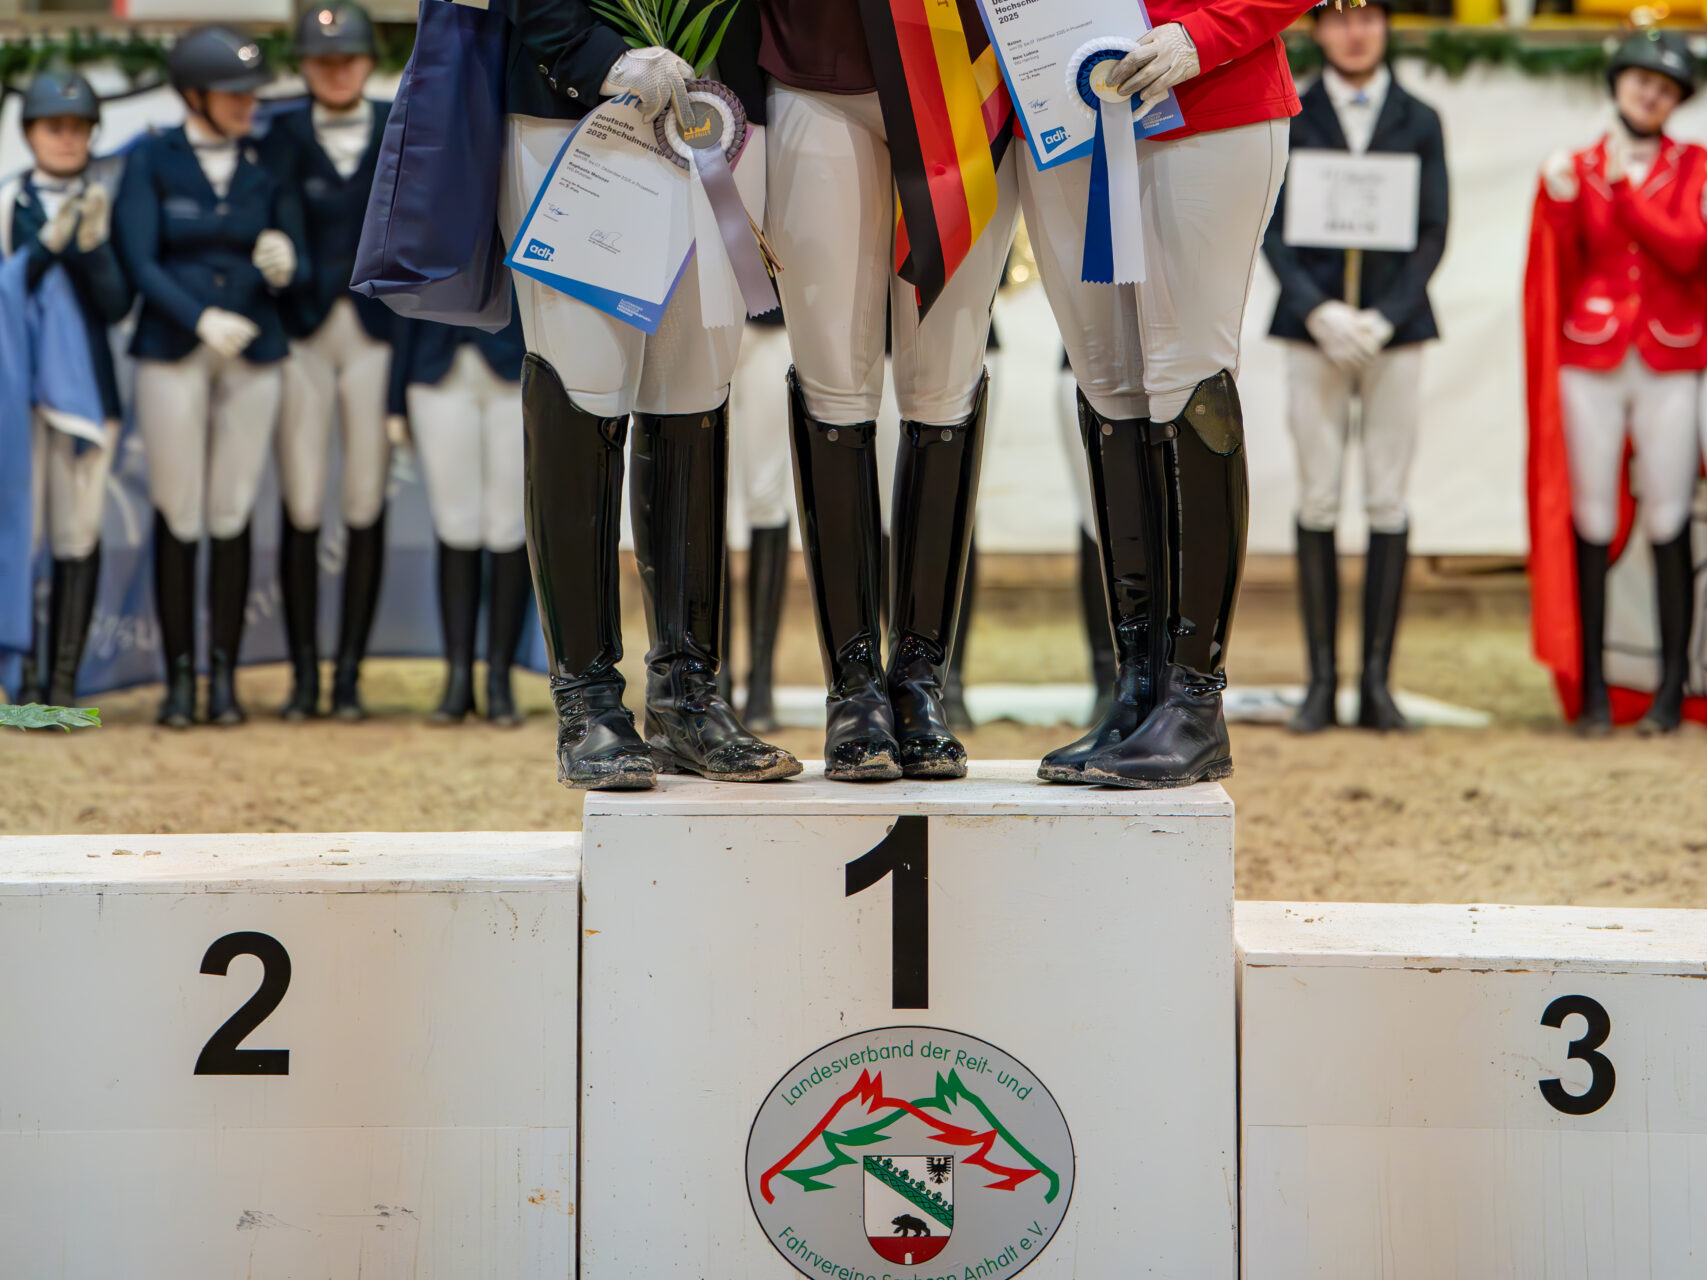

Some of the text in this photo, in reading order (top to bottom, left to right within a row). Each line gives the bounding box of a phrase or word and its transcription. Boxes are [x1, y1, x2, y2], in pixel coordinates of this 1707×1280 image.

[998, 11, 1020, 24] 2025
[586, 127, 608, 141] 2025
[590, 120, 666, 157] Hochschulmeister
[595, 113, 635, 132] Deutsche
[845, 815, 929, 1010] 1
[193, 931, 292, 1075] 2
[781, 1040, 1033, 1106] Landesverband der Reit- und
[1538, 994, 1616, 1116] 3
[964, 1246, 1018, 1280] Anhalt
[1020, 1220, 1049, 1251] e.V.
